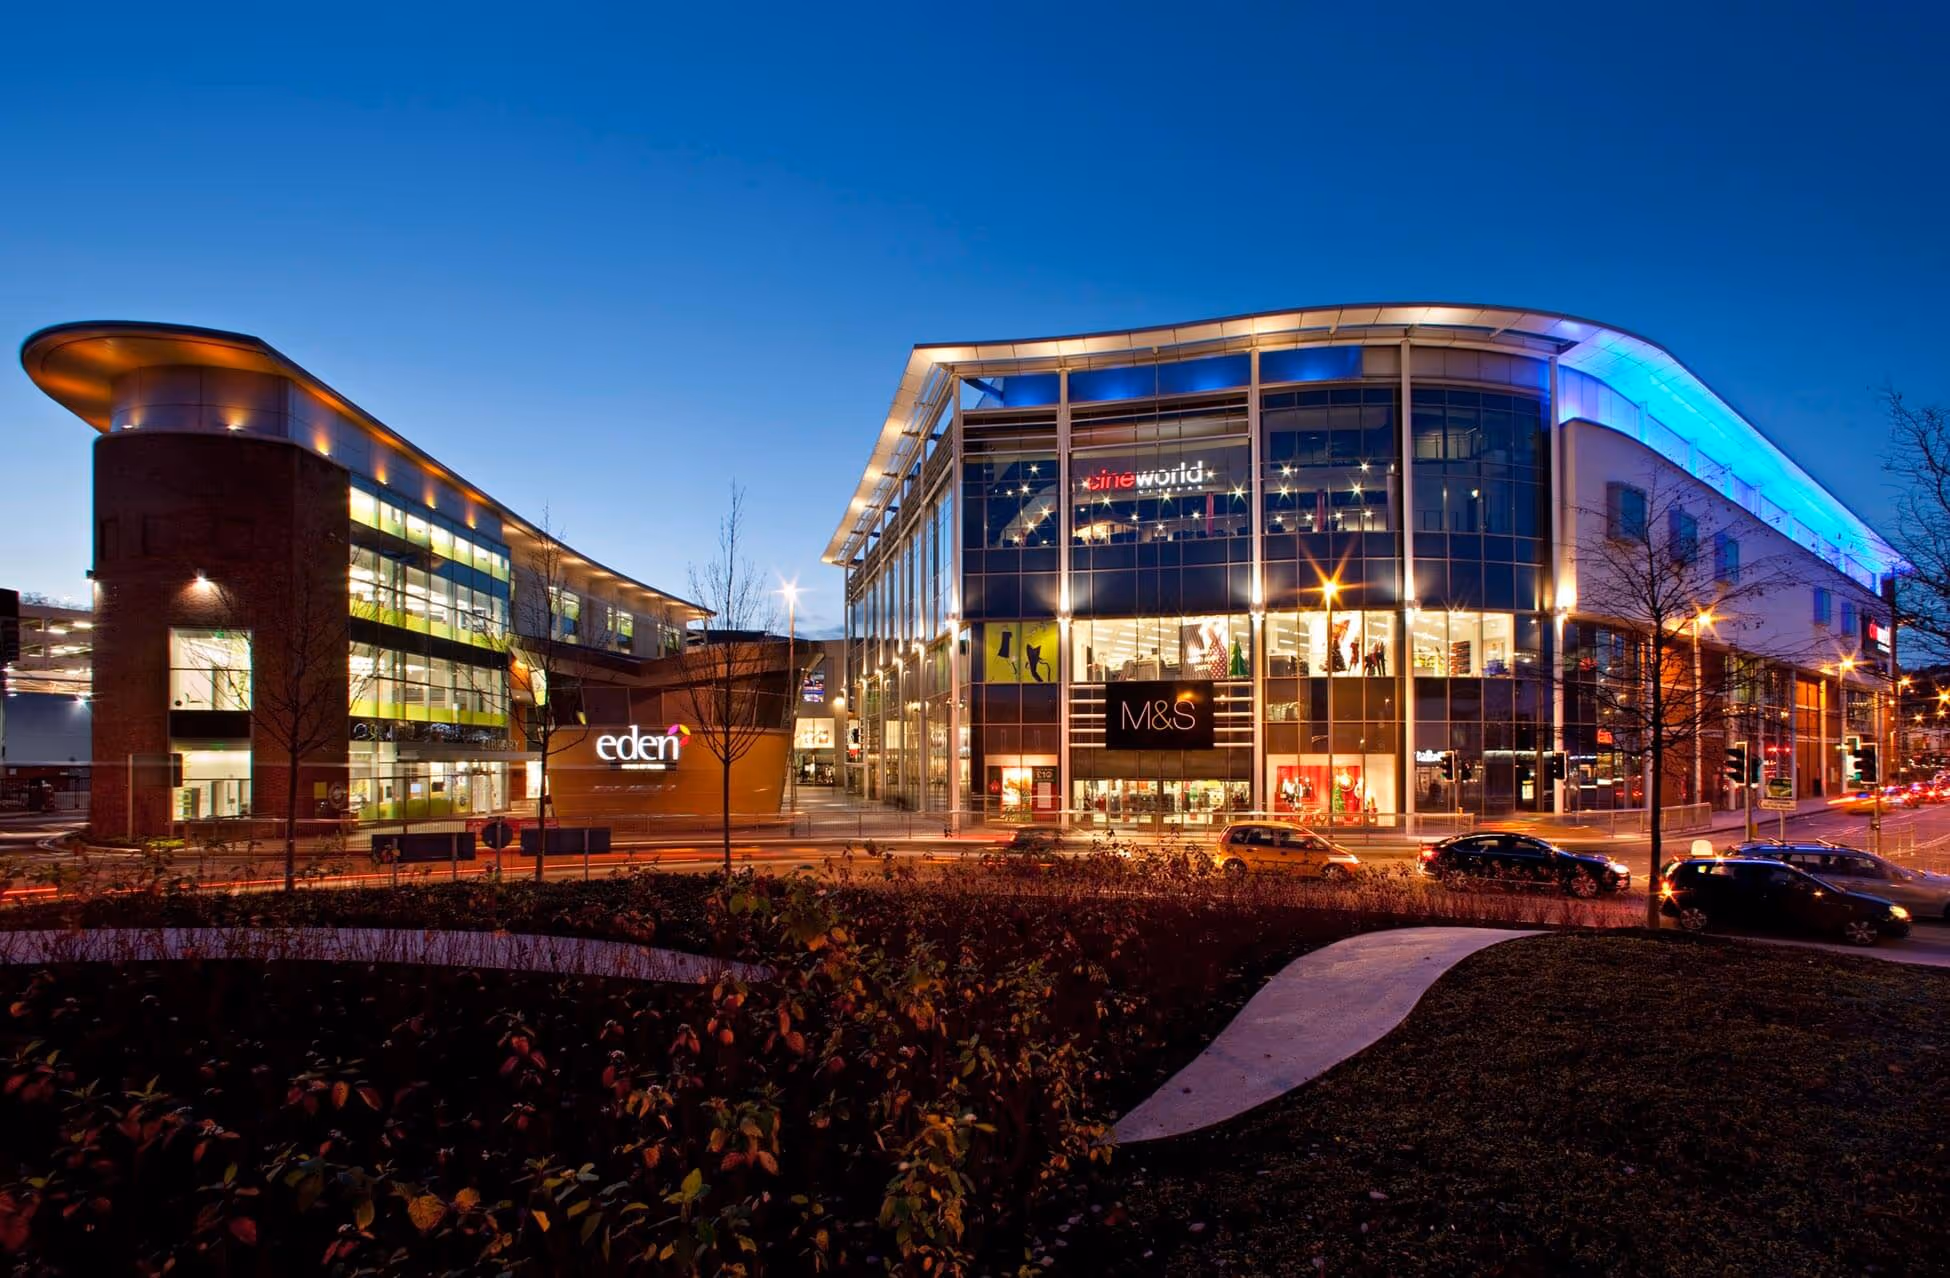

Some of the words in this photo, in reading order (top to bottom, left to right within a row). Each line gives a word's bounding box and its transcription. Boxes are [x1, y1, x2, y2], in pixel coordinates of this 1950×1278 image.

[1088, 461, 1203, 491] cineworld
[1122, 700, 1196, 731] M&S
[596, 724, 680, 761] eden
